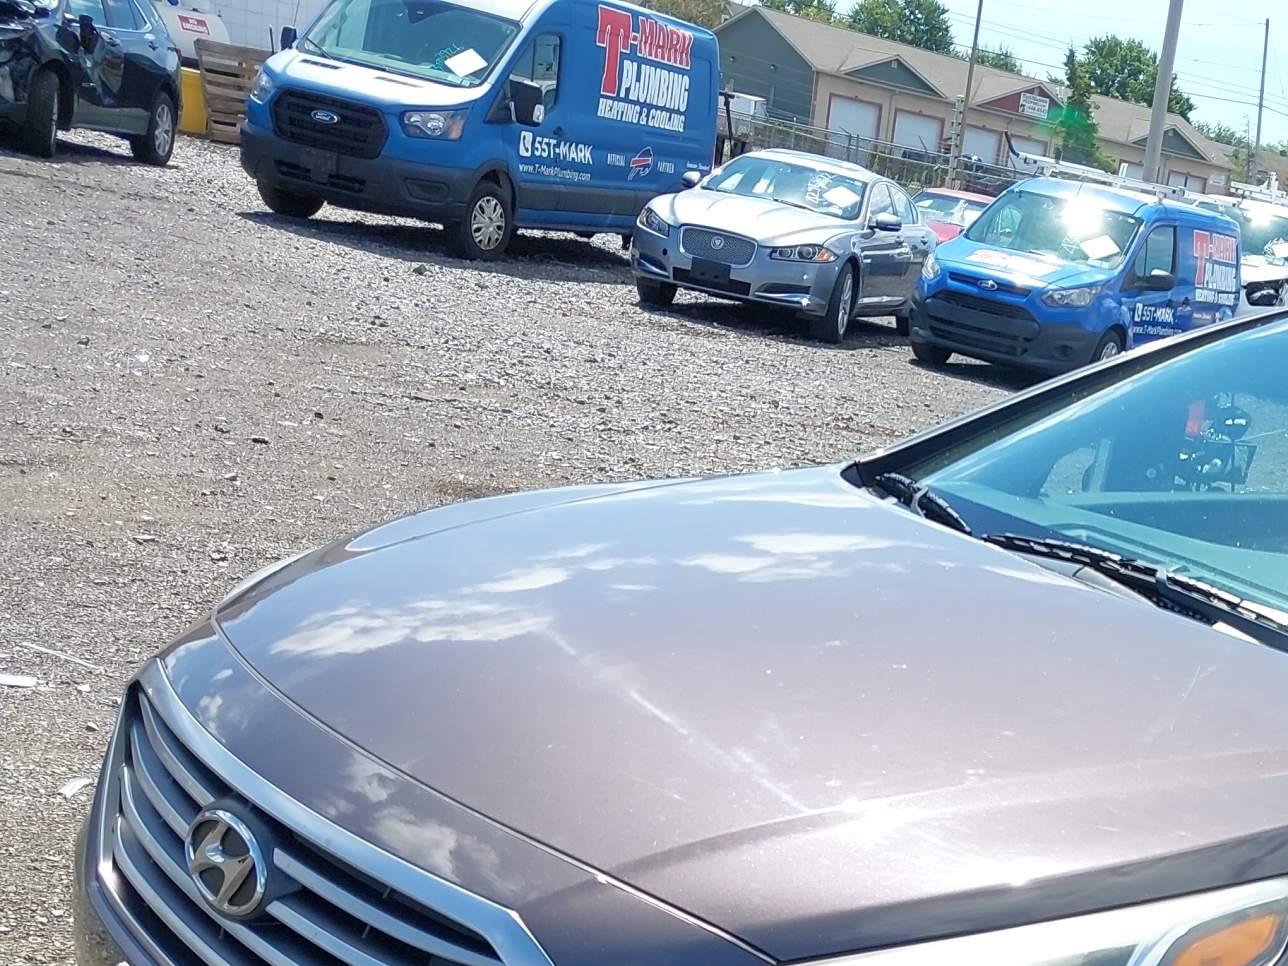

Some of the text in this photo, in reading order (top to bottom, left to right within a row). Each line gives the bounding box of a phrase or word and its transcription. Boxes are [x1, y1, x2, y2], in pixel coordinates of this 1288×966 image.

[596, 4, 694, 97] T-MARK
[620, 60, 690, 113] PLUMBING
[597, 97, 685, 132] HEATING & COOLING
[534, 136, 593, 165] 55T-MARK
